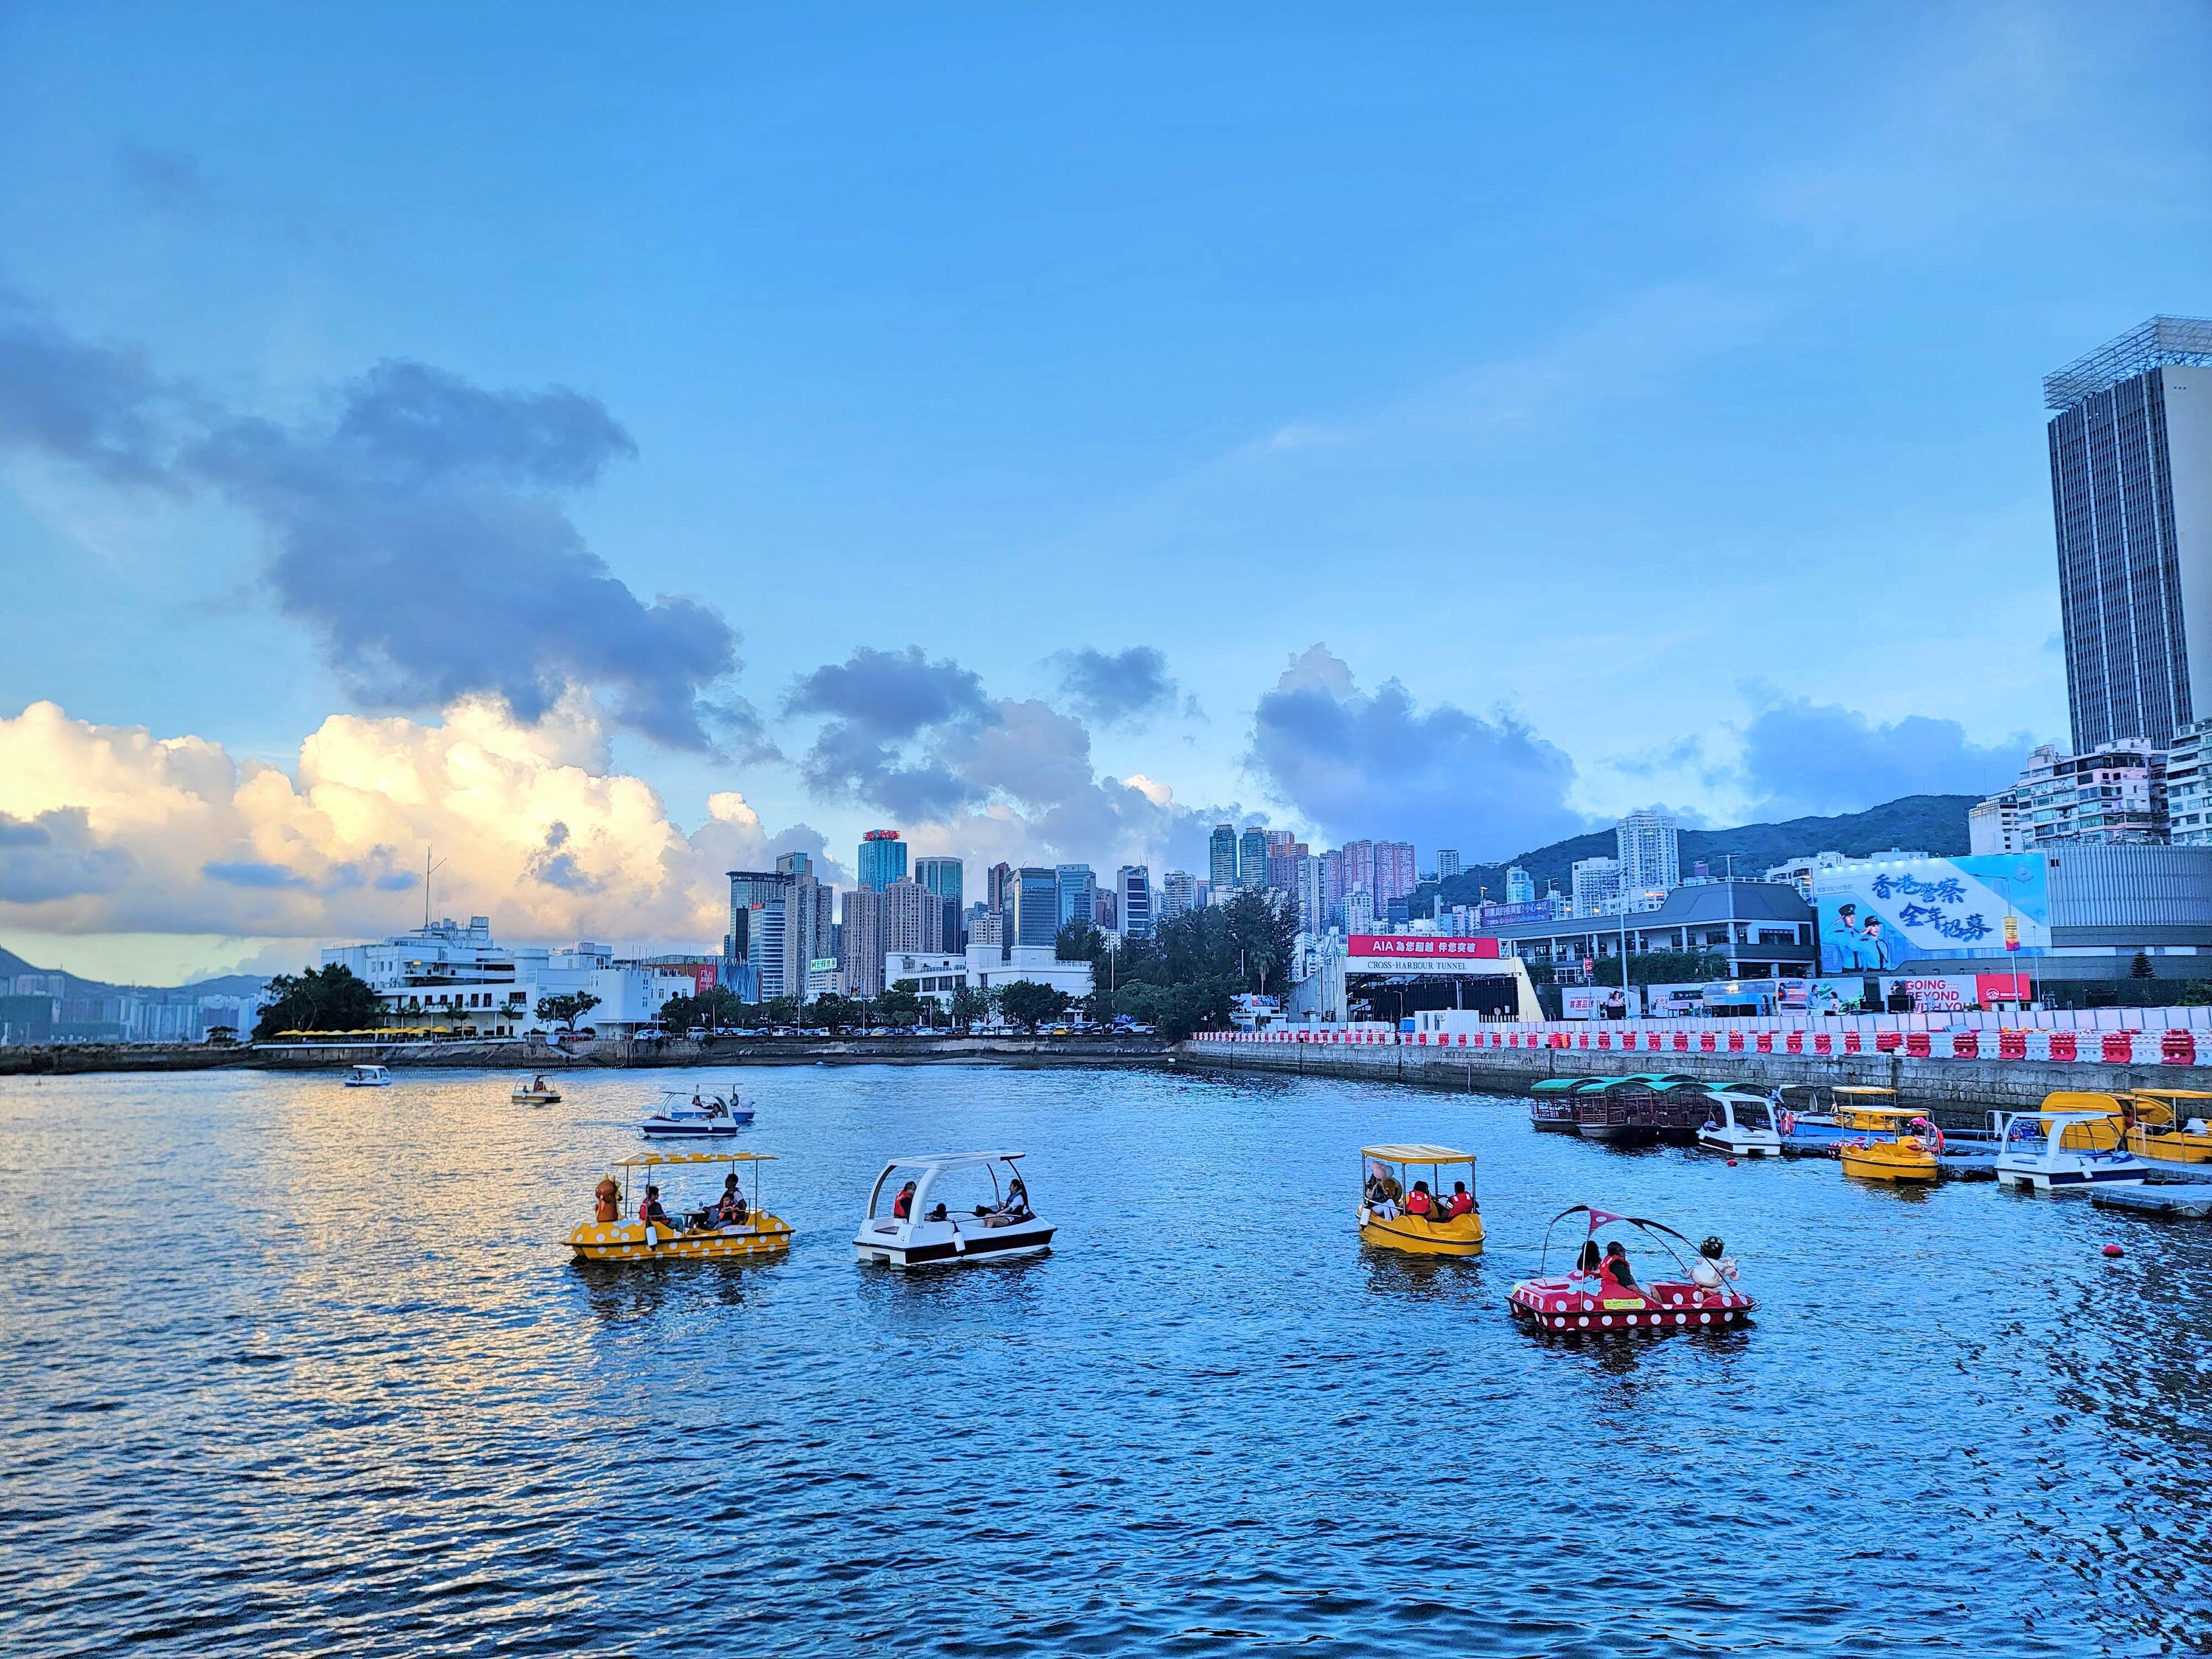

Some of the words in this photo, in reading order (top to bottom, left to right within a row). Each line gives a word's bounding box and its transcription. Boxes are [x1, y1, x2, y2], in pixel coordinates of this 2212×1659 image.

[1871, 873, 1967, 903] 香港警察
[1899, 902, 1994, 942] 全年招募
[1372, 941, 1394, 952] AIA
[1396, 941, 1434, 953] 為您超越
[1439, 942, 1476, 953] 伴您突破
[1367, 961, 1433, 970] CROSS-HARBOUR
[1437, 961, 1467, 970] TUNNEL
[1905, 980, 1947, 990] GOING
